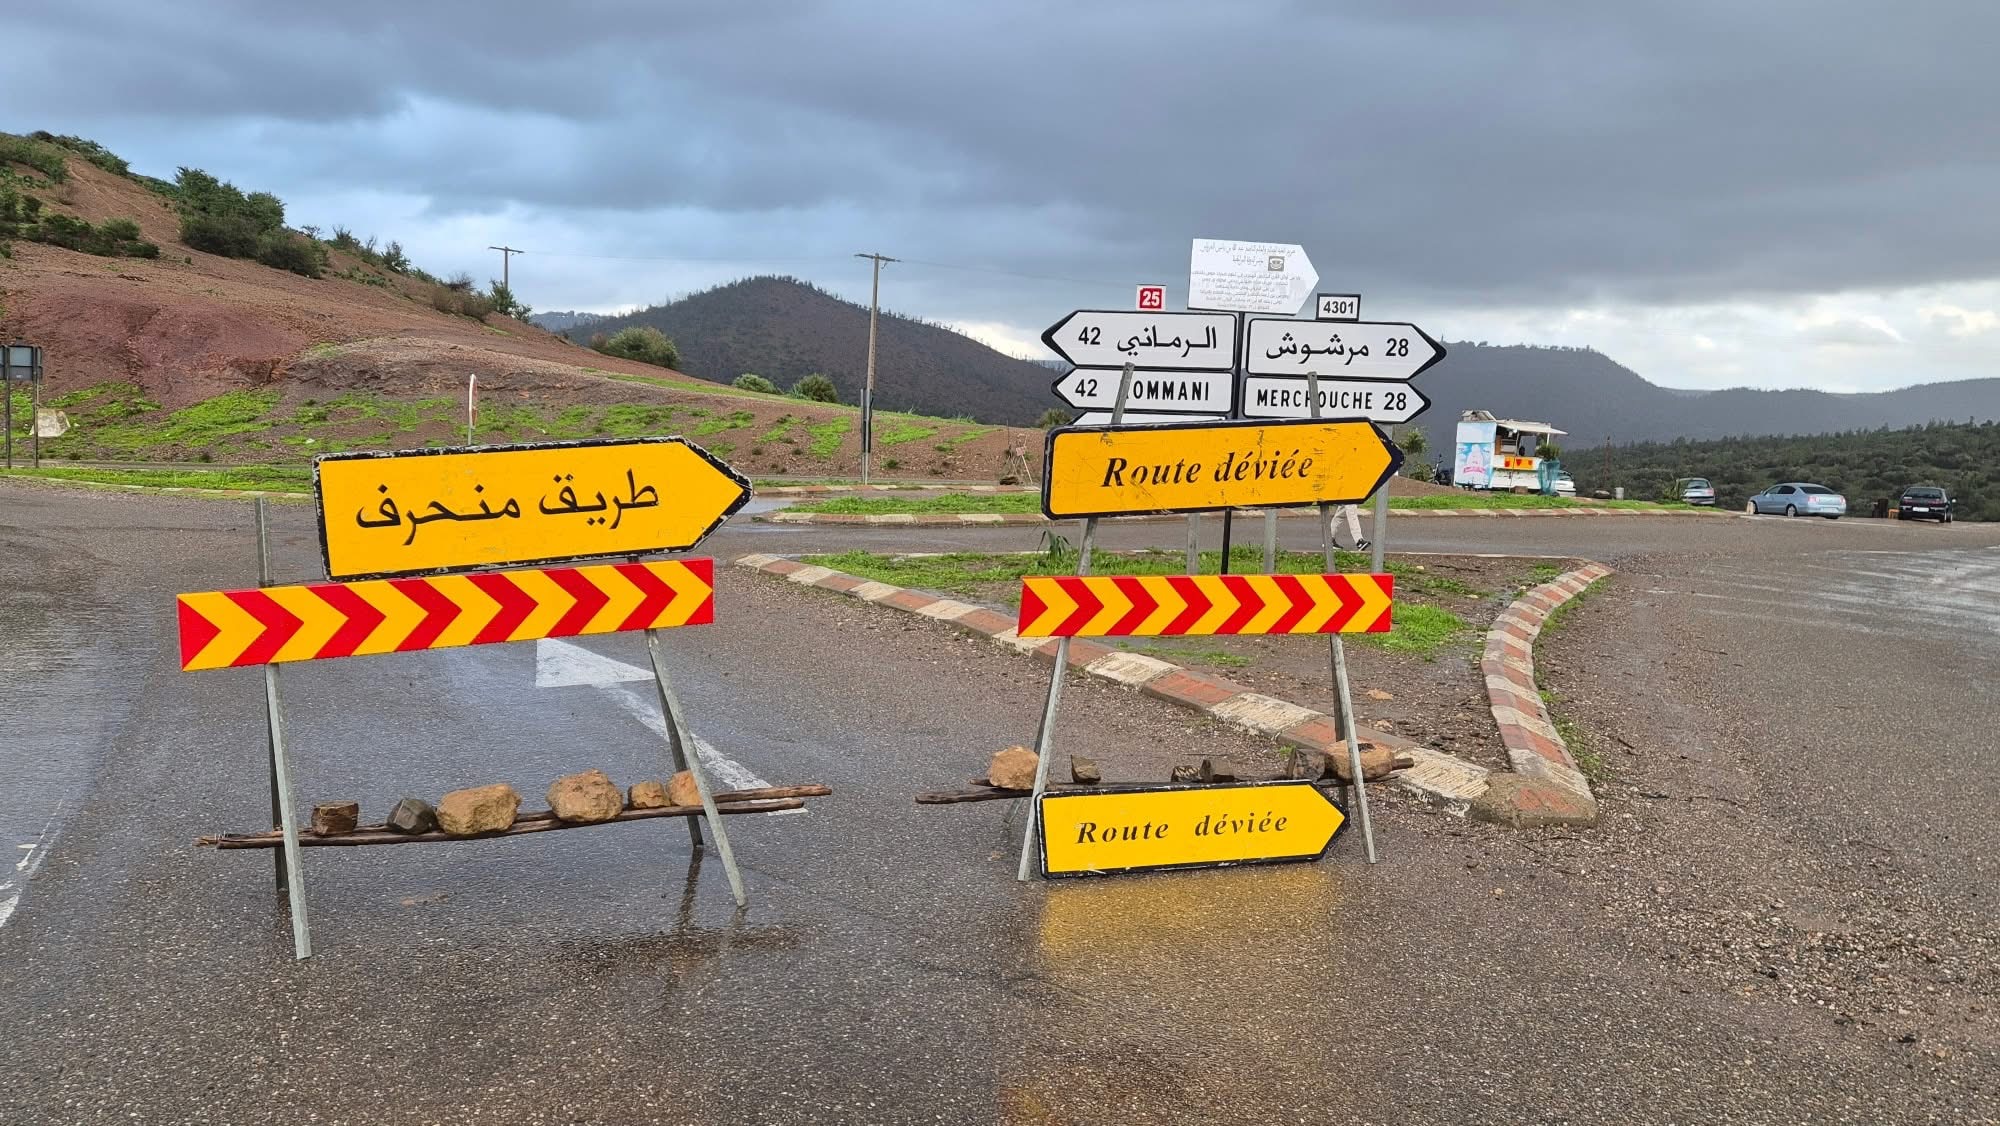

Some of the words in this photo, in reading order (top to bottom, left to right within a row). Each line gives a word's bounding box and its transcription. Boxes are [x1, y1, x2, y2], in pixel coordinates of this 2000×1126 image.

[1141, 290, 1161, 307] 25
[1323, 299, 1355, 315] 4301
[1078, 326, 1101, 346] 42
[1117, 325, 1217, 358] الرماني
[1265, 332, 1369, 366] مرشوش
[1385, 337, 1409, 357] 28
[1074, 378, 1098, 397] 42
[1126, 380, 1209, 401] OMMANI
[1383, 391, 1407, 411] 28
[1101, 457, 1202, 488] Route
[1214, 449, 1313, 482] déviée
[355, 484, 521, 546] منحرف
[538, 468, 659, 530] طريق
[1076, 821, 1170, 845] Route
[1194, 811, 1288, 838] déviée
